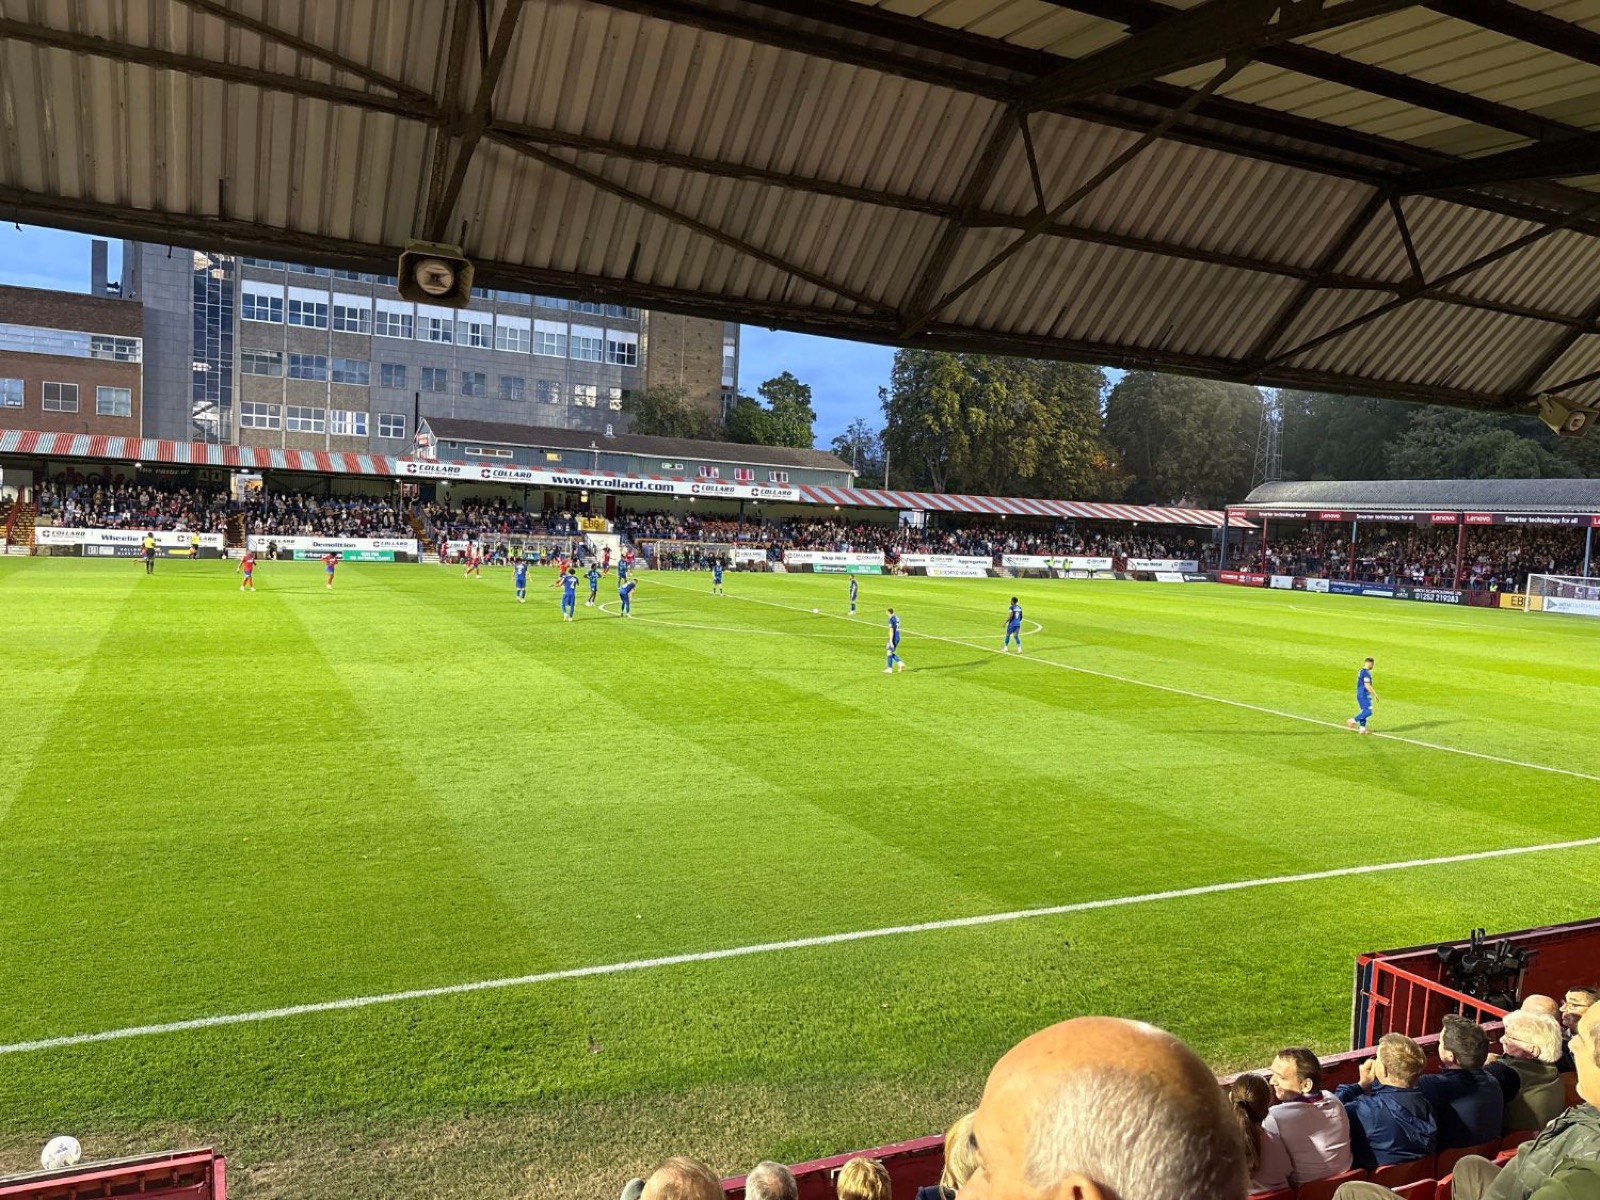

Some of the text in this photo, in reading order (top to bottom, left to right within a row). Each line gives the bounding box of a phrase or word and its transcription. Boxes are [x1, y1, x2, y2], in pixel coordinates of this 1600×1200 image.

[419, 464, 461, 475] COLLARD
[493, 469, 533, 479] COLLARD
[551, 475, 675, 492] www.rcollard.com
[701, 484, 735, 493] COLLARD
[760, 488, 793, 496] COLLARD
[1374, 513, 1400, 521] technology
[1432, 514, 1455, 522] Lenovo
[1466, 515, 1491, 523] Lenovo
[1528, 516, 1560, 525] technology
[1415, 592, 1435, 601] 01252
